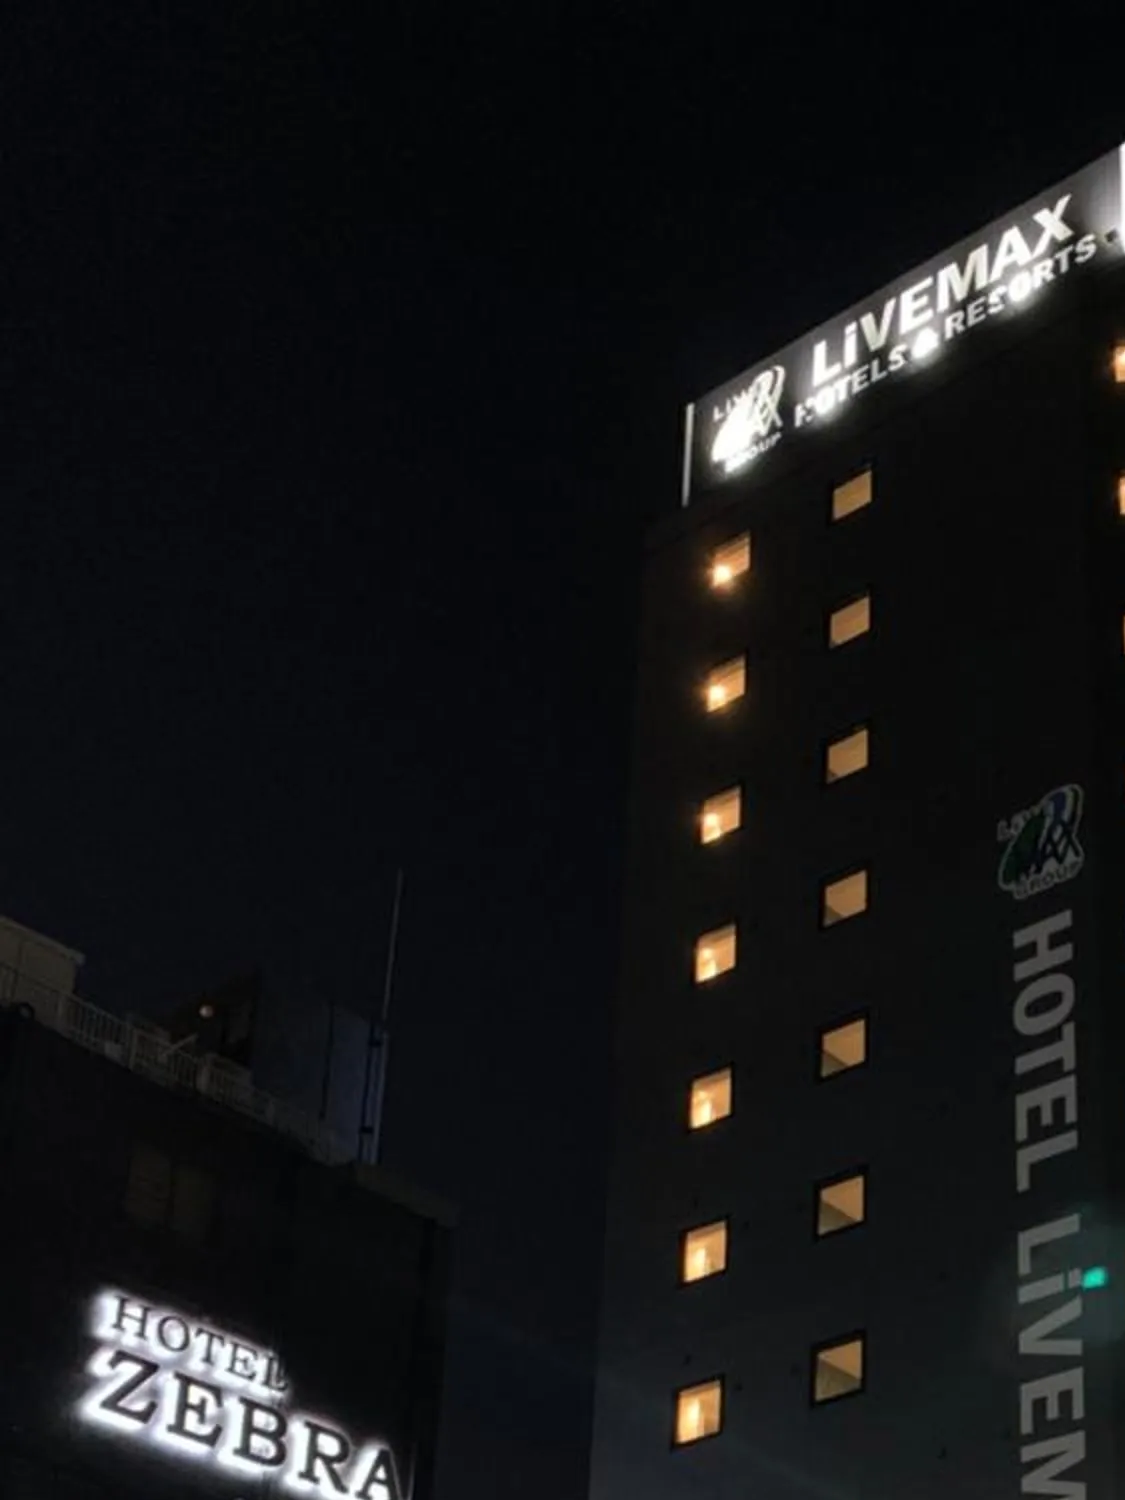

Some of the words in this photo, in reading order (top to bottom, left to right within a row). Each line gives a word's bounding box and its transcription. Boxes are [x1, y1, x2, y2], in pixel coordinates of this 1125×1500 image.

[945, 233, 1098, 342] RESORTS
[1013, 909, 1078, 1192] HOTEL
[111, 1295, 289, 1393] HOTEL
